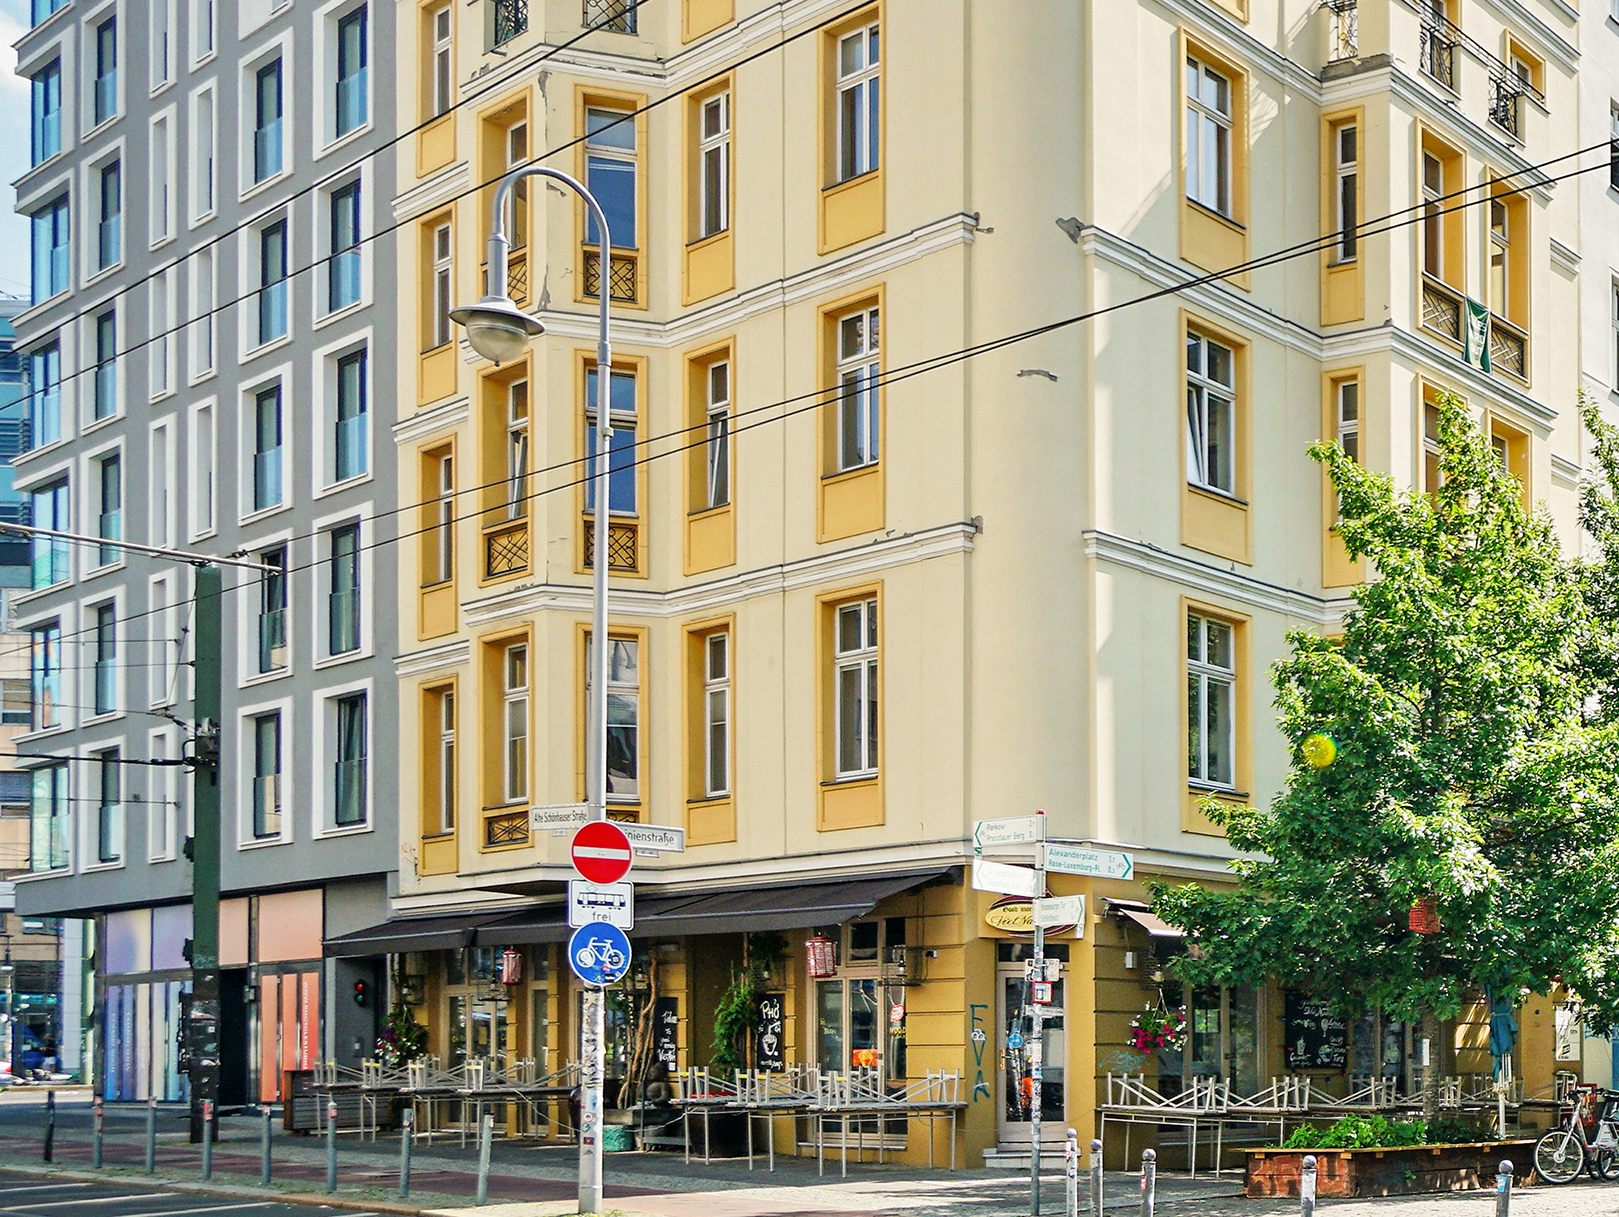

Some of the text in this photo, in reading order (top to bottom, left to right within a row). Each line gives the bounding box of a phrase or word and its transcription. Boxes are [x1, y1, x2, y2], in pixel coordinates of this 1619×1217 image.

[534, 810, 587, 824] Alte Schönhauser Straße
[624, 828, 674, 846] inienstraße
[1048, 848, 1098, 861] Alexanderplatz
[592, 911, 611, 922] frei
